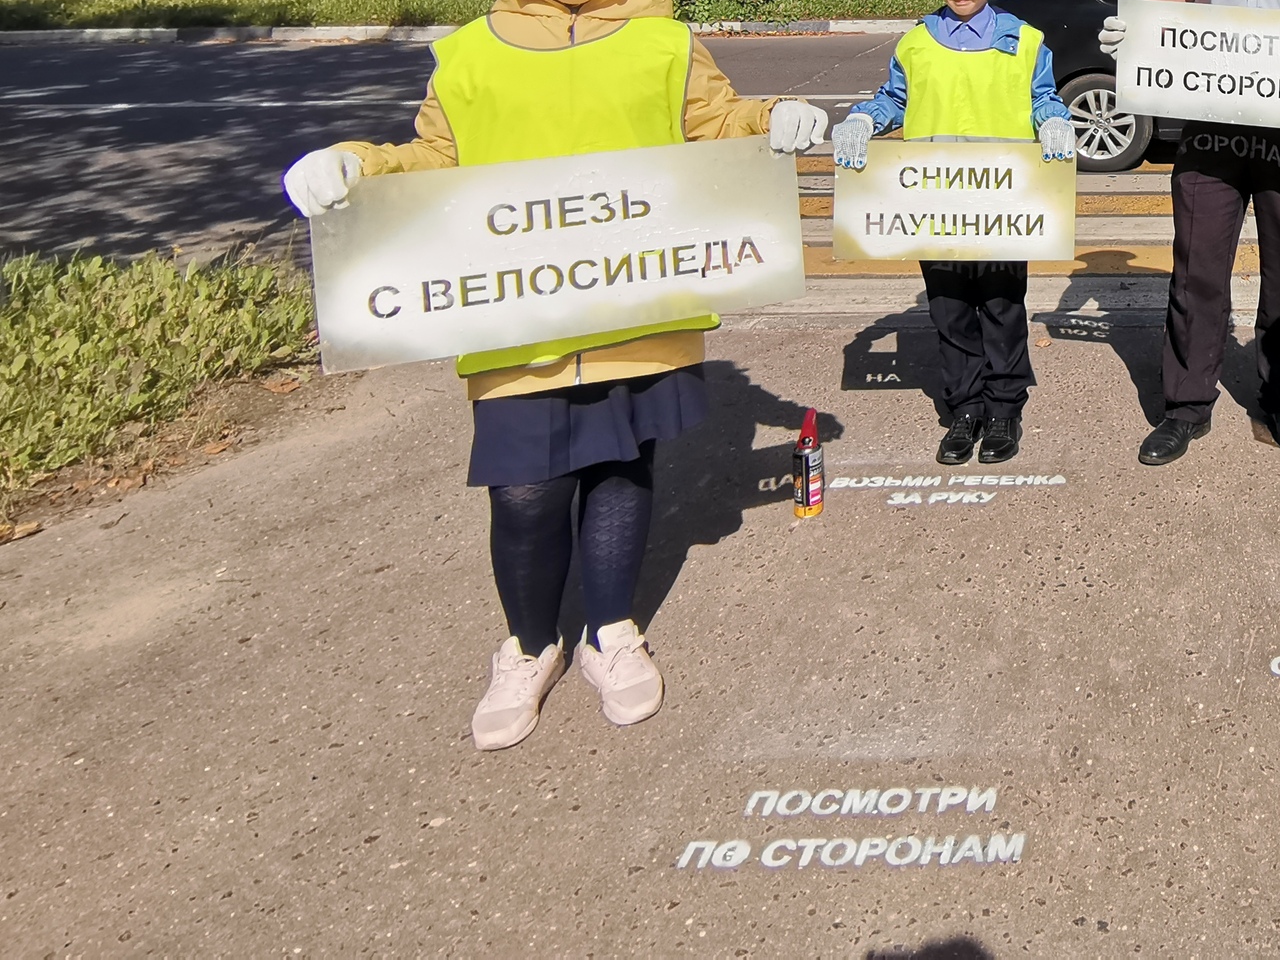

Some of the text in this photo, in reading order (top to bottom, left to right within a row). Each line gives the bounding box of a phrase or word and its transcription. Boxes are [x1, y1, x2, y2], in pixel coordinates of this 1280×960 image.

[1136, 66, 1174, 89] ПО
[899, 166, 1013, 190] СНИМИ
[486, 189, 652, 236] СЛЕЗЬ
[865, 212, 1045, 236] НАУШНИКИ
[367, 235, 764, 319] С ВЕЛОСИПЕДА
[829, 474, 1068, 489] ВОЗЬМИ РЕБЕНКА
[886, 491, 999, 505] ЗА РУКУ
[743, 787, 998, 817] ПОСМОТРИ
[676, 833, 1026, 869] ПО СТОРОНАМ
